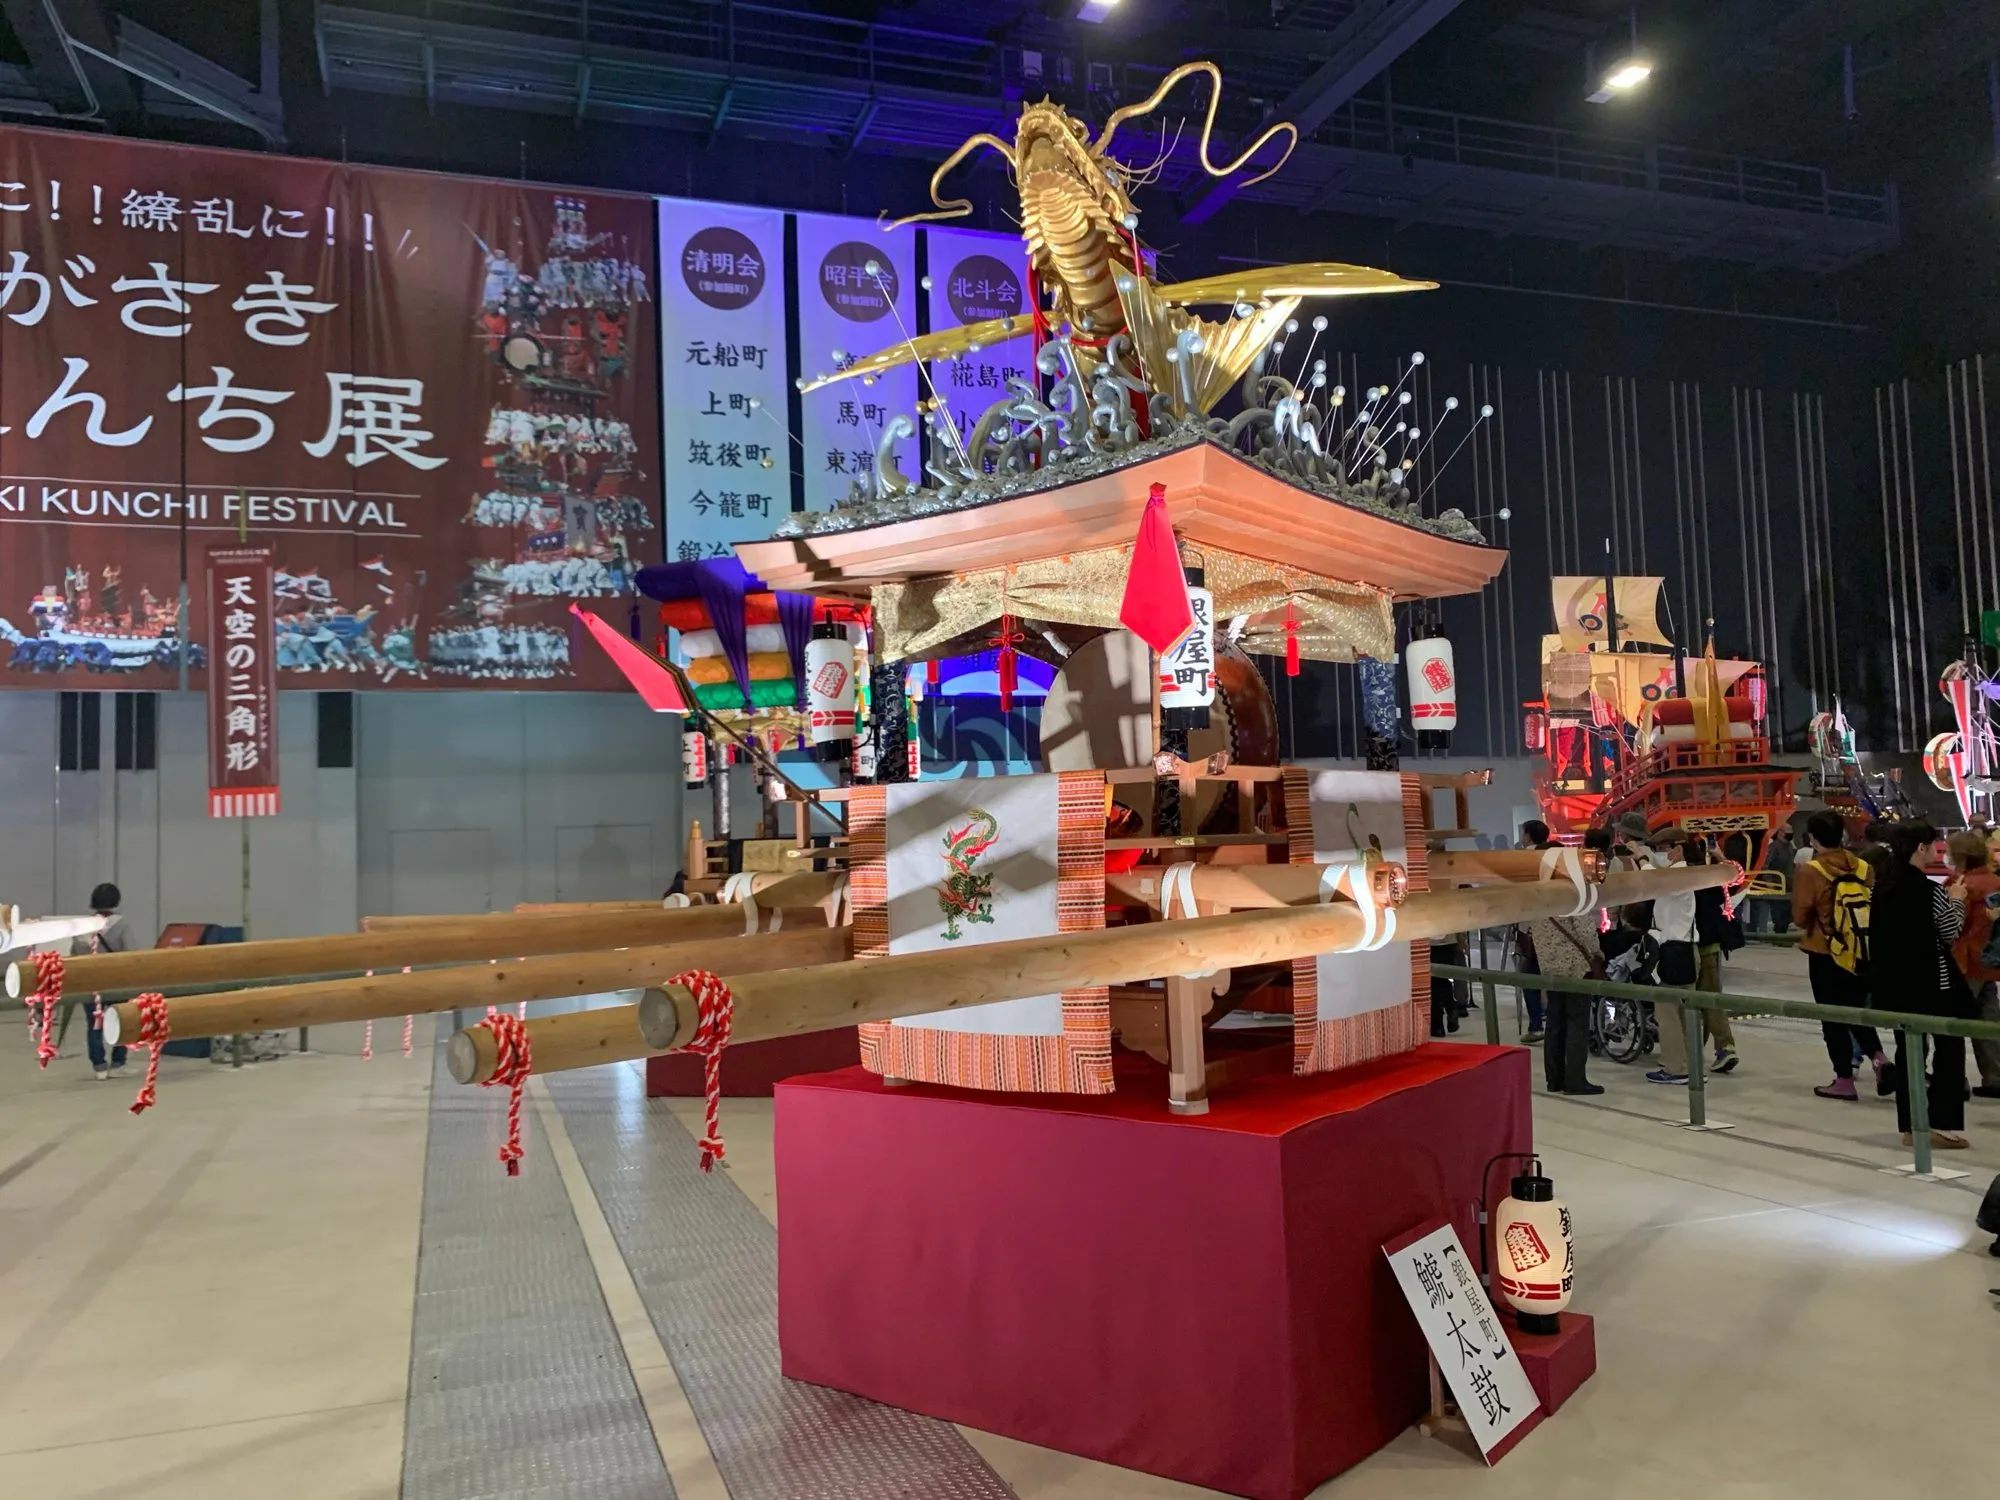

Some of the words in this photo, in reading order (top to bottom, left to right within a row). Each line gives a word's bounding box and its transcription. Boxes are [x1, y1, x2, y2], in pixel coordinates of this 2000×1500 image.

[685, 248, 760, 278] 清明会
[952, 277, 1018, 304] 北斗会
[685, 341, 768, 370] 元船町
[0, 357, 450, 470] んち展
[701, 390, 752, 419] 上町
[836, 400, 887, 428] 馬町
[687, 438, 772, 469] 筑後町
[41, 486, 208, 520] KUNCHI
[223, 494, 407, 528] FESTIVAL
[688, 488, 773, 519] 今籠町
[224, 576, 259, 771] 天空の三角形
